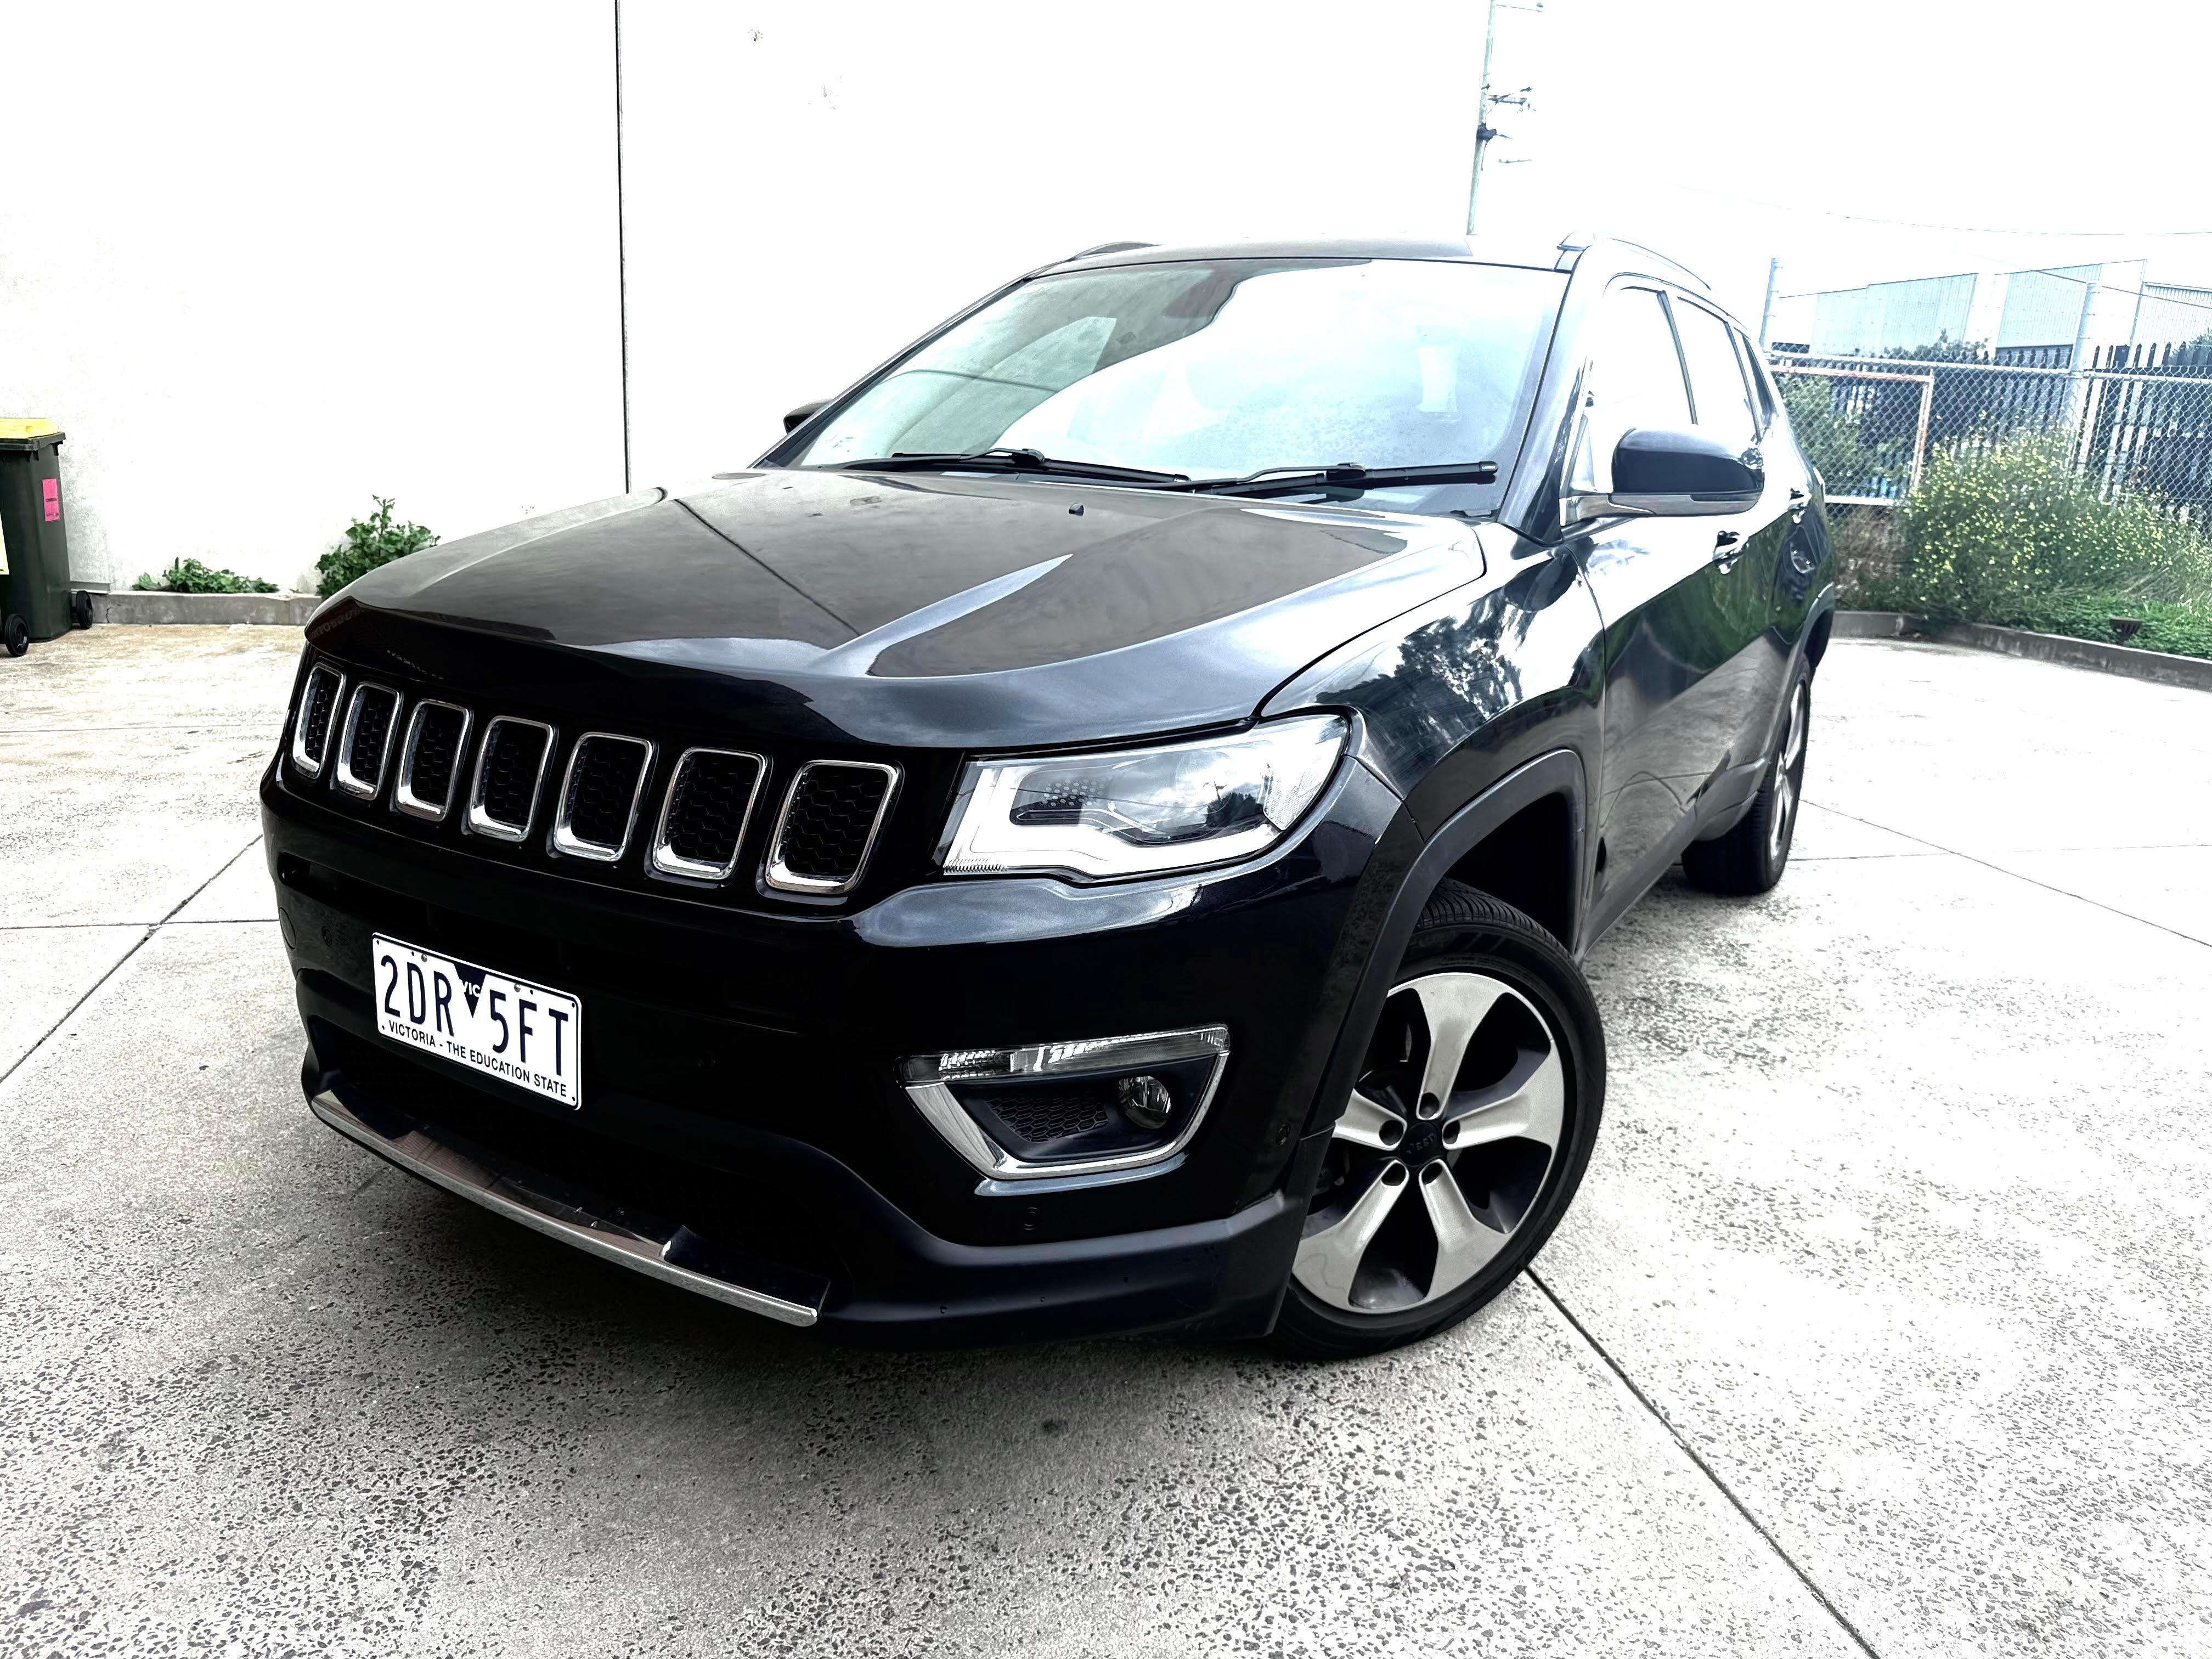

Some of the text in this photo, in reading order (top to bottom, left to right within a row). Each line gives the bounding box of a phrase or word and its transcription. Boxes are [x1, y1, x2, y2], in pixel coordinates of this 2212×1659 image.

[381, 955, 569, 1077] 2DR 5FT
[460, 979, 481, 998] VIC
[389, 1020, 436, 1048] VICTORIA
[447, 1040, 466, 1059] THE
[470, 1049, 530, 1083] EDUCATION
[534, 1074, 567, 1097] STATE
